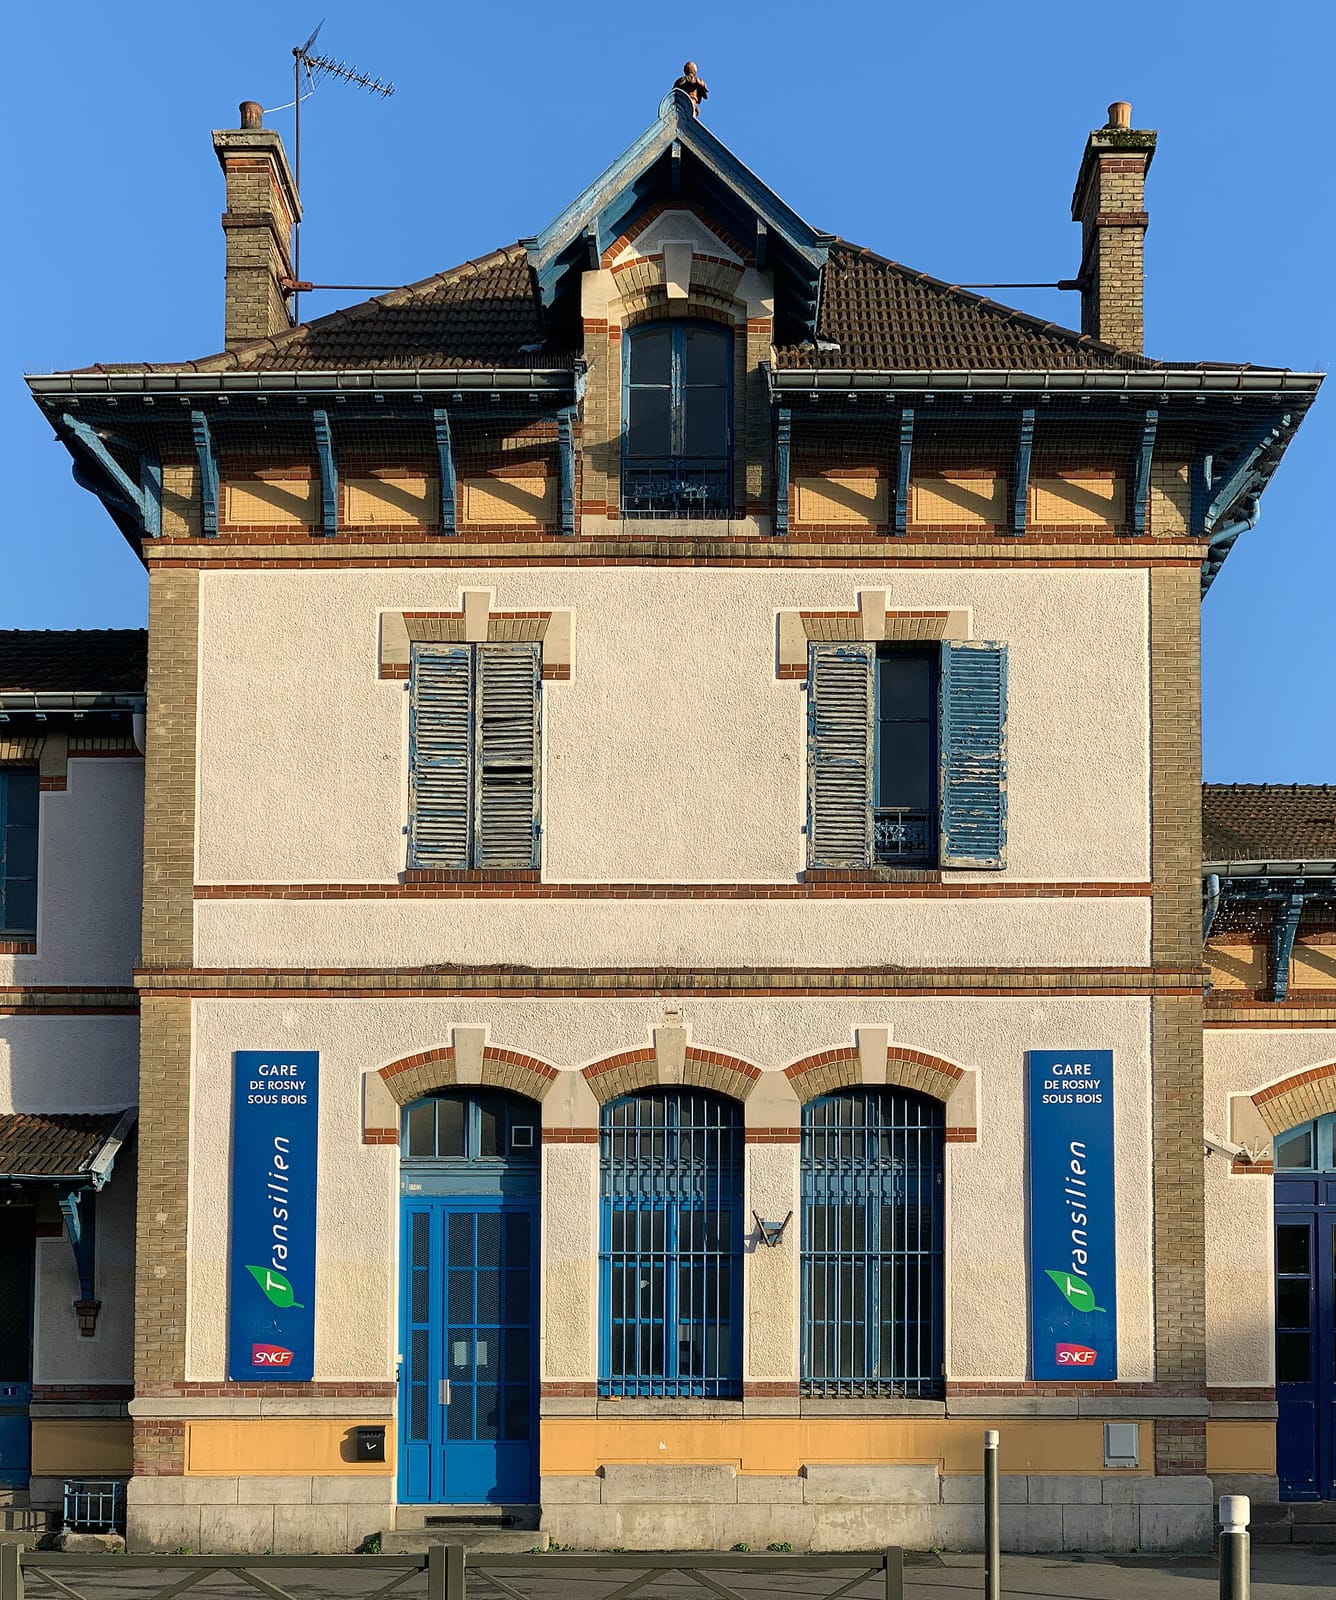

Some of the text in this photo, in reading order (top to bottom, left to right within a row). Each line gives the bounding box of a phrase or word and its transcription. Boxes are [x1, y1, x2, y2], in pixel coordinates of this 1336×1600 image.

[258, 1064, 298, 1076] GARE
[1052, 1063, 1092, 1076] GARE
[250, 1080, 306, 1090] DE ROSNY
[1044, 1080, 1101, 1090] DE ROSNY
[247, 1094, 308, 1104] SOUS BOIS
[1042, 1094, 1103, 1104] SOUS BOIS
[265, 1135, 290, 1291] Transilien
[1065, 1140, 1088, 1297] Transilien
[253, 1351, 292, 1363] SNCF
[1057, 1351, 1095, 1363] SNCF
